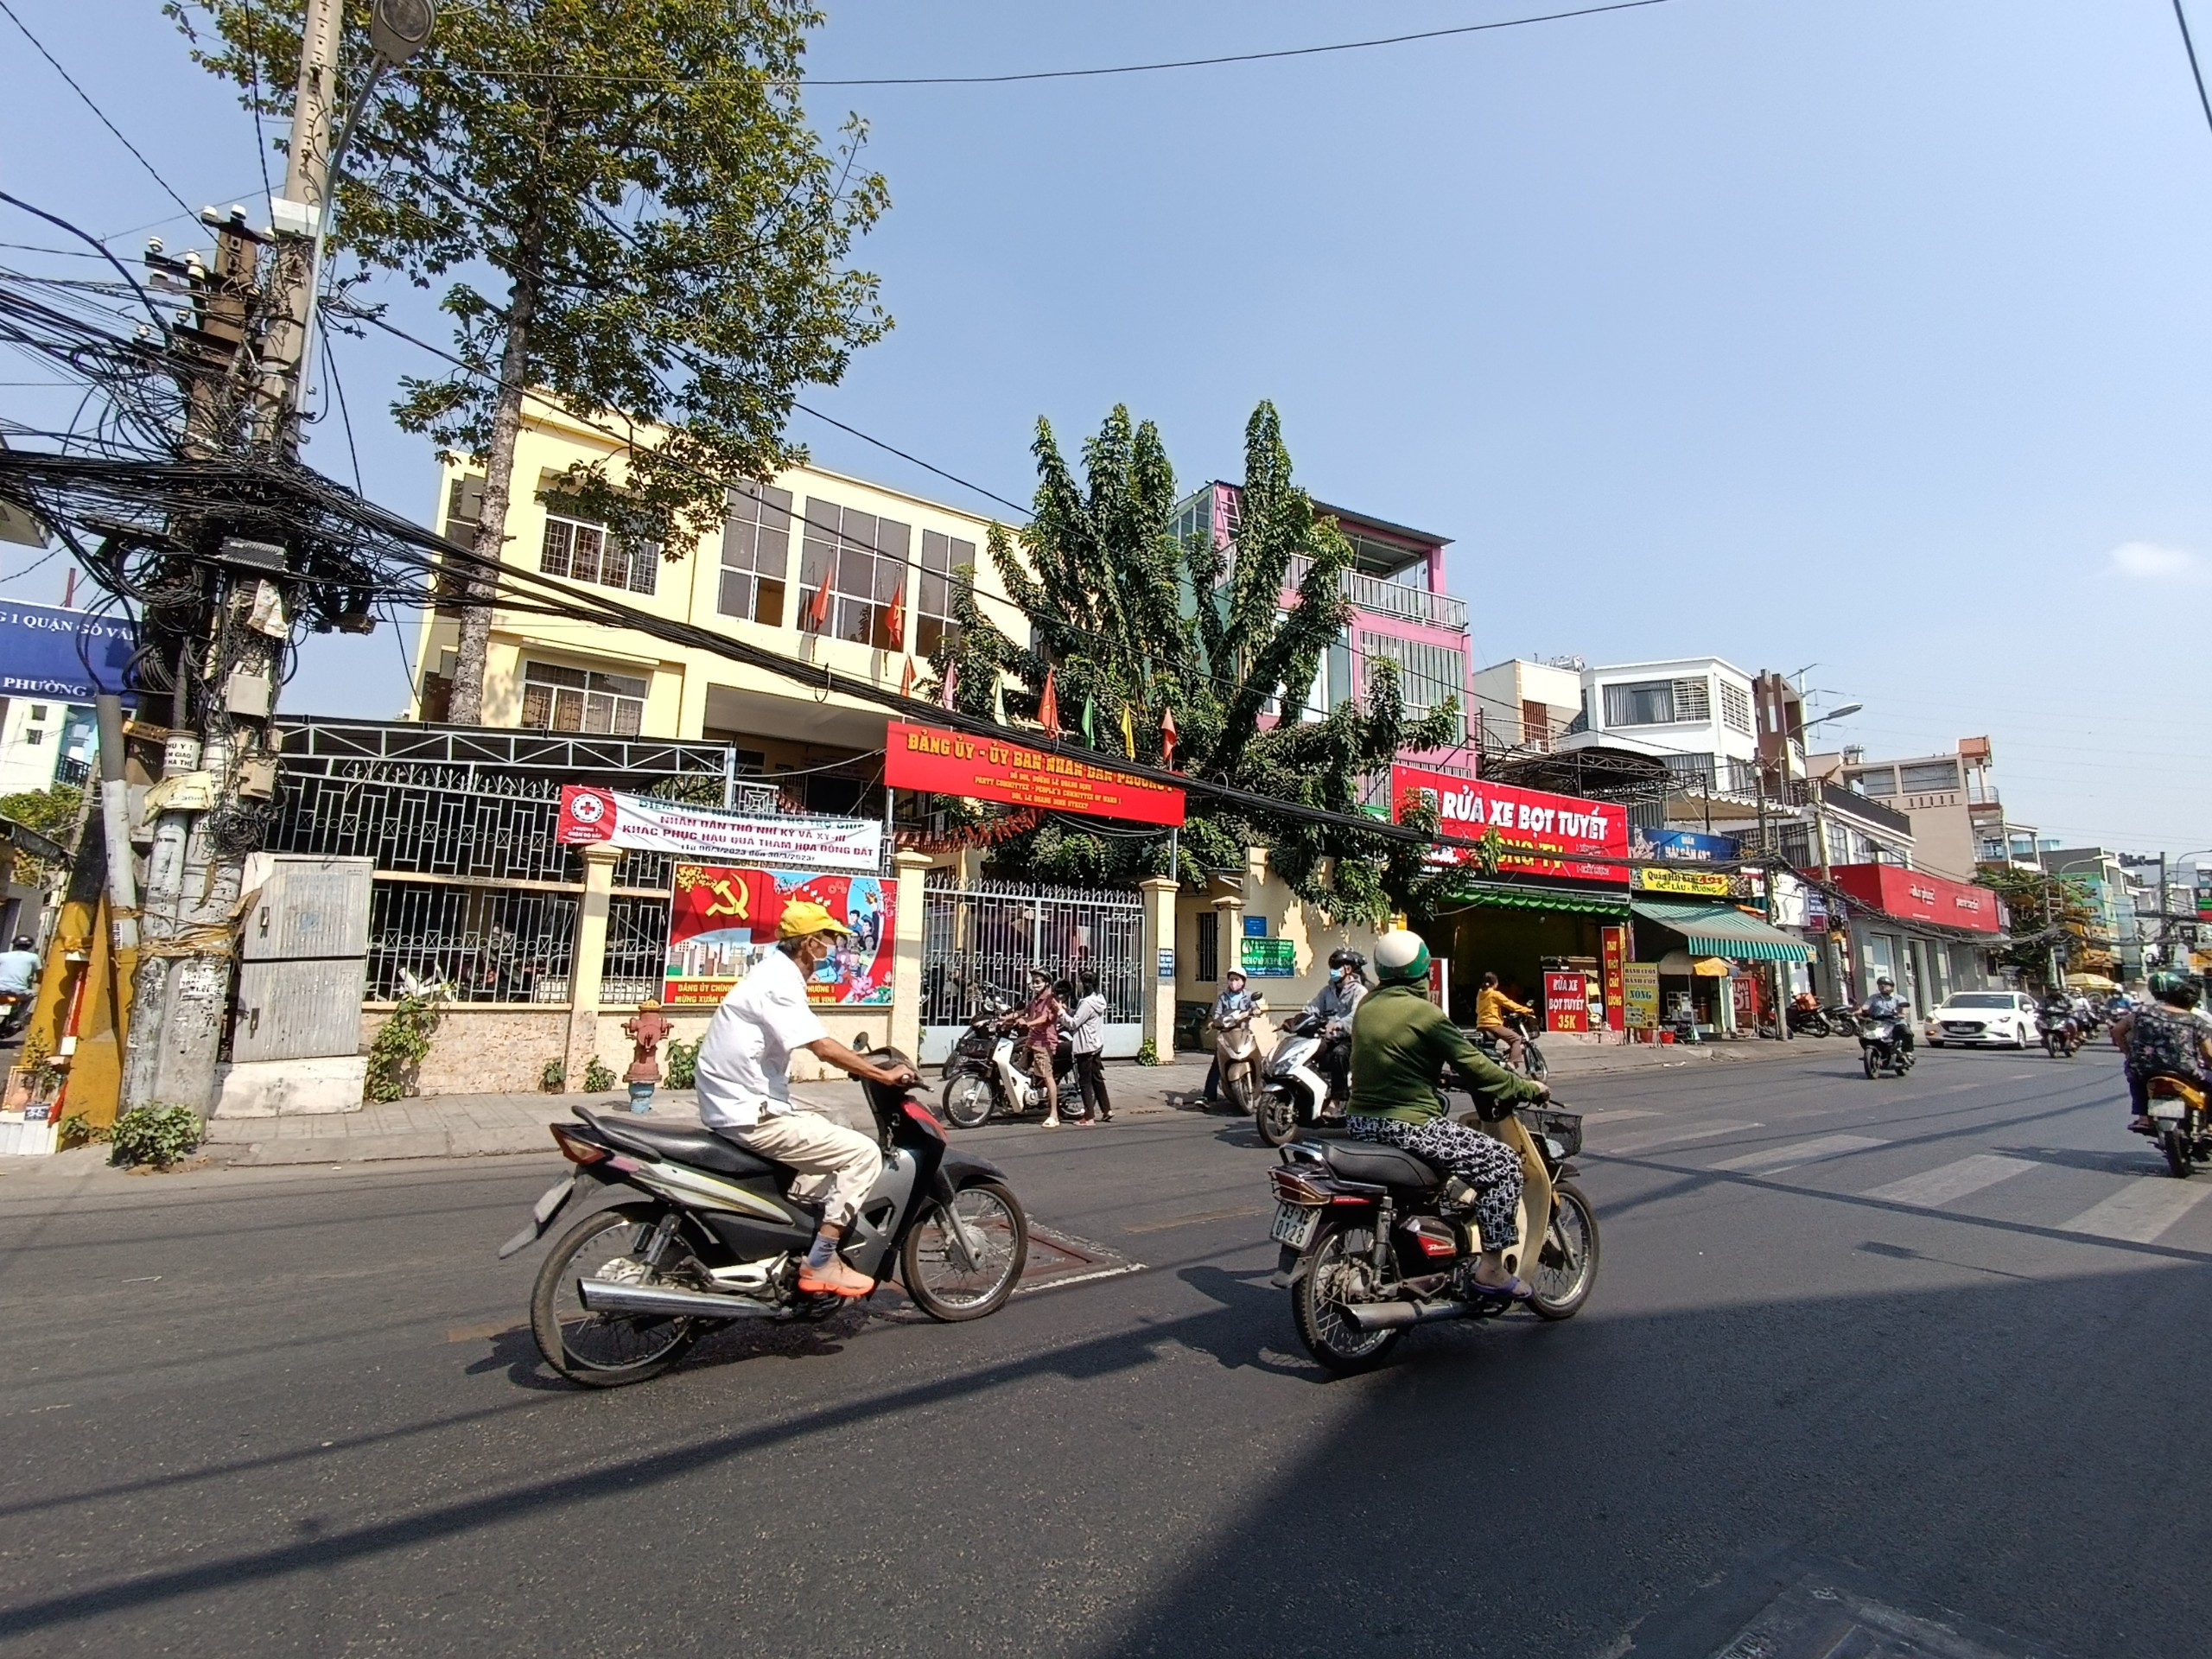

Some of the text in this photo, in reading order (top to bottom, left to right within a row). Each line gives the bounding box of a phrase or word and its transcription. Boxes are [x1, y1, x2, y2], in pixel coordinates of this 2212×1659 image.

[11, 613, 18, 624] 1
[23, 614, 73, 632] QUẬN
[76, 622, 103, 636] GÒ
[3, 677, 87, 697] PHƯỜNG
[908, 729, 950, 756] ĐẢNG
[954, 735, 975, 760] ỦY
[988, 741, 1009, 766] ỦY
[1013, 751, 1042, 771] BAN
[975, 776, 994, 785] PARTY
[995, 779, 1029, 791] COMMITTEE
[1063, 789, 1094, 801] COMMITTEE
[1067, 800, 1089, 810] STREET
[1441, 785, 1608, 841] RỬA XE BỌT TUYẾT
[663, 830, 697, 842] PHỤC
[702, 831, 726, 845] HẬU
[795, 842, 817, 852] HỌA
[1681, 835, 1695, 845] QUÁN
[1647, 871, 1667, 881] Quán
[1656, 880, 1666, 889] ỐC
[677, 983, 698, 993] ĐẢNG
[699, 982, 709, 993] ỦY
[830, 985, 836, 994] 1
[1553, 975, 1578, 991] RỬA XE
[675, 994, 696, 1004] MỪNG
[698, 995, 719, 1004] XUÂN
[1629, 987, 1652, 1000] NÓNG
[1548, 994, 1585, 1013] BỌT TUYẾT
[1558, 1014, 1576, 1029] 35K
[1275, 1219, 1305, 1244] 0128
